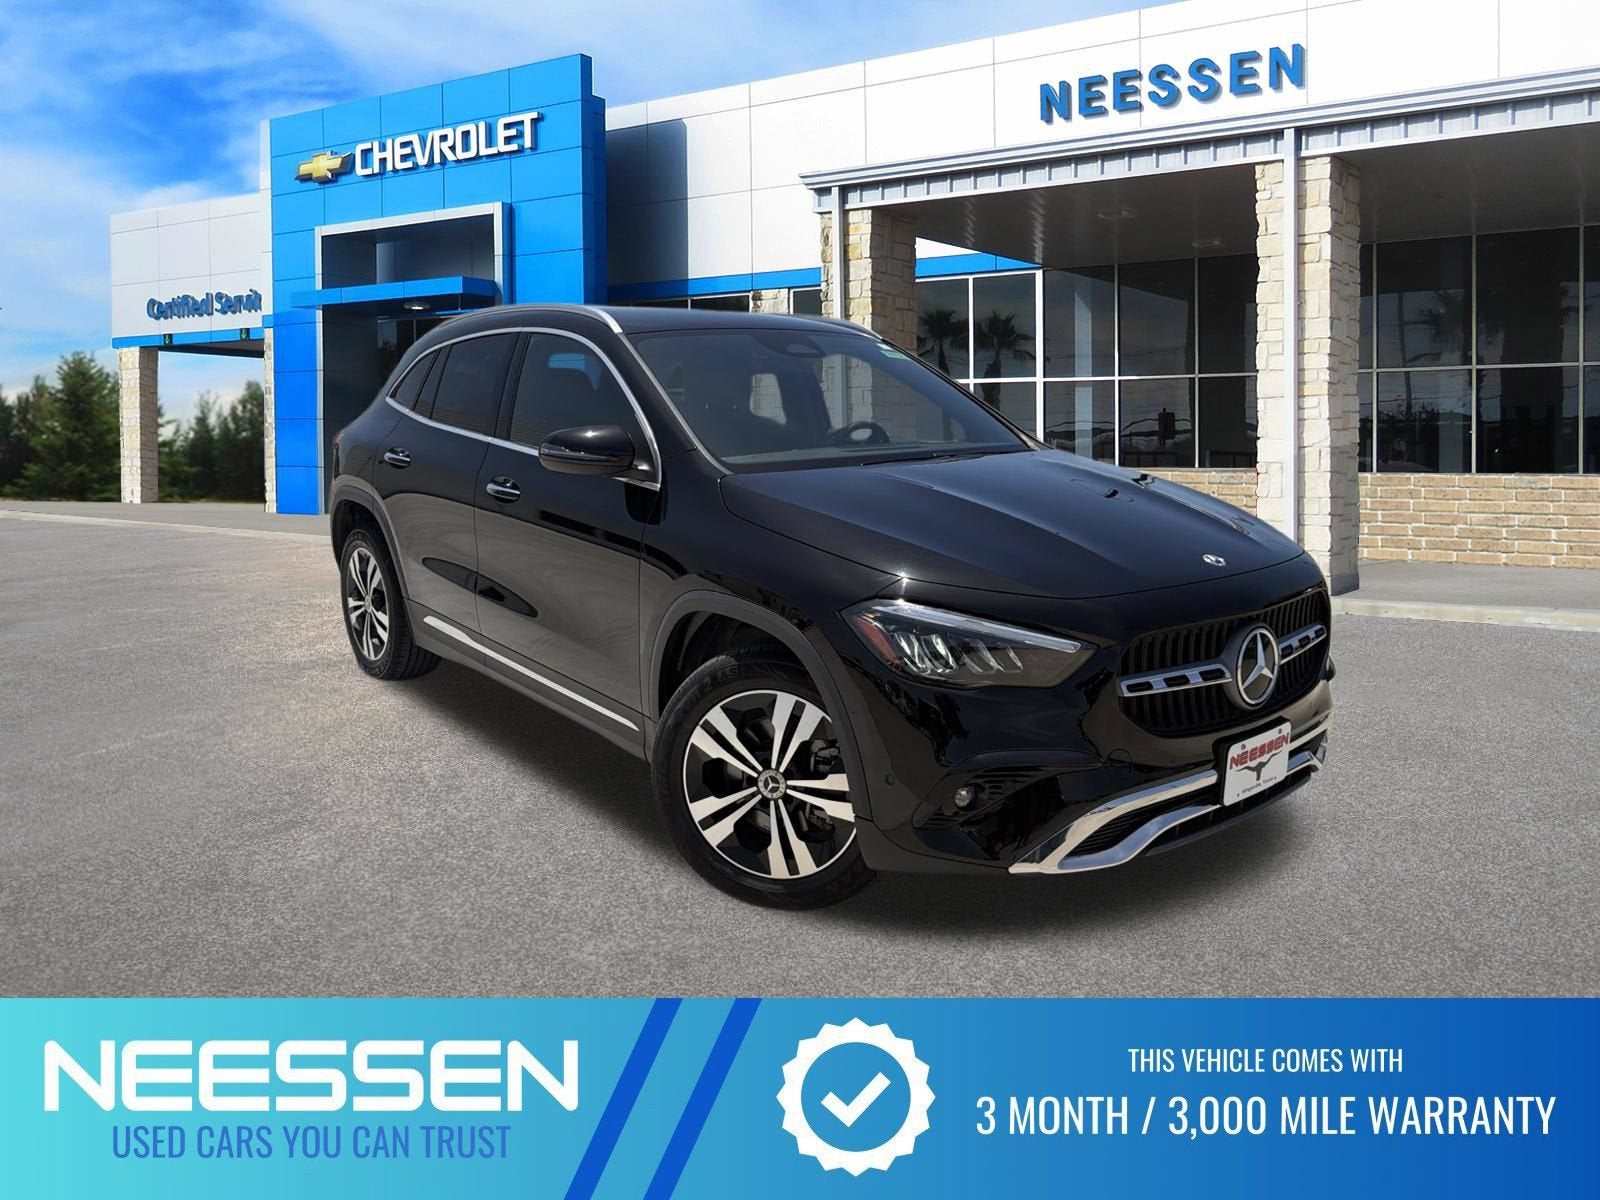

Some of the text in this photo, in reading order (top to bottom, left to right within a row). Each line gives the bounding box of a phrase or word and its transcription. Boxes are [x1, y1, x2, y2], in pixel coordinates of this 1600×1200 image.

[1040, 43, 1305, 124] NEESSEN
[354, 111, 541, 177] CHEVROLET
[146, 291, 214, 320] Certified
[1229, 731, 1290, 770] NEESSEN
